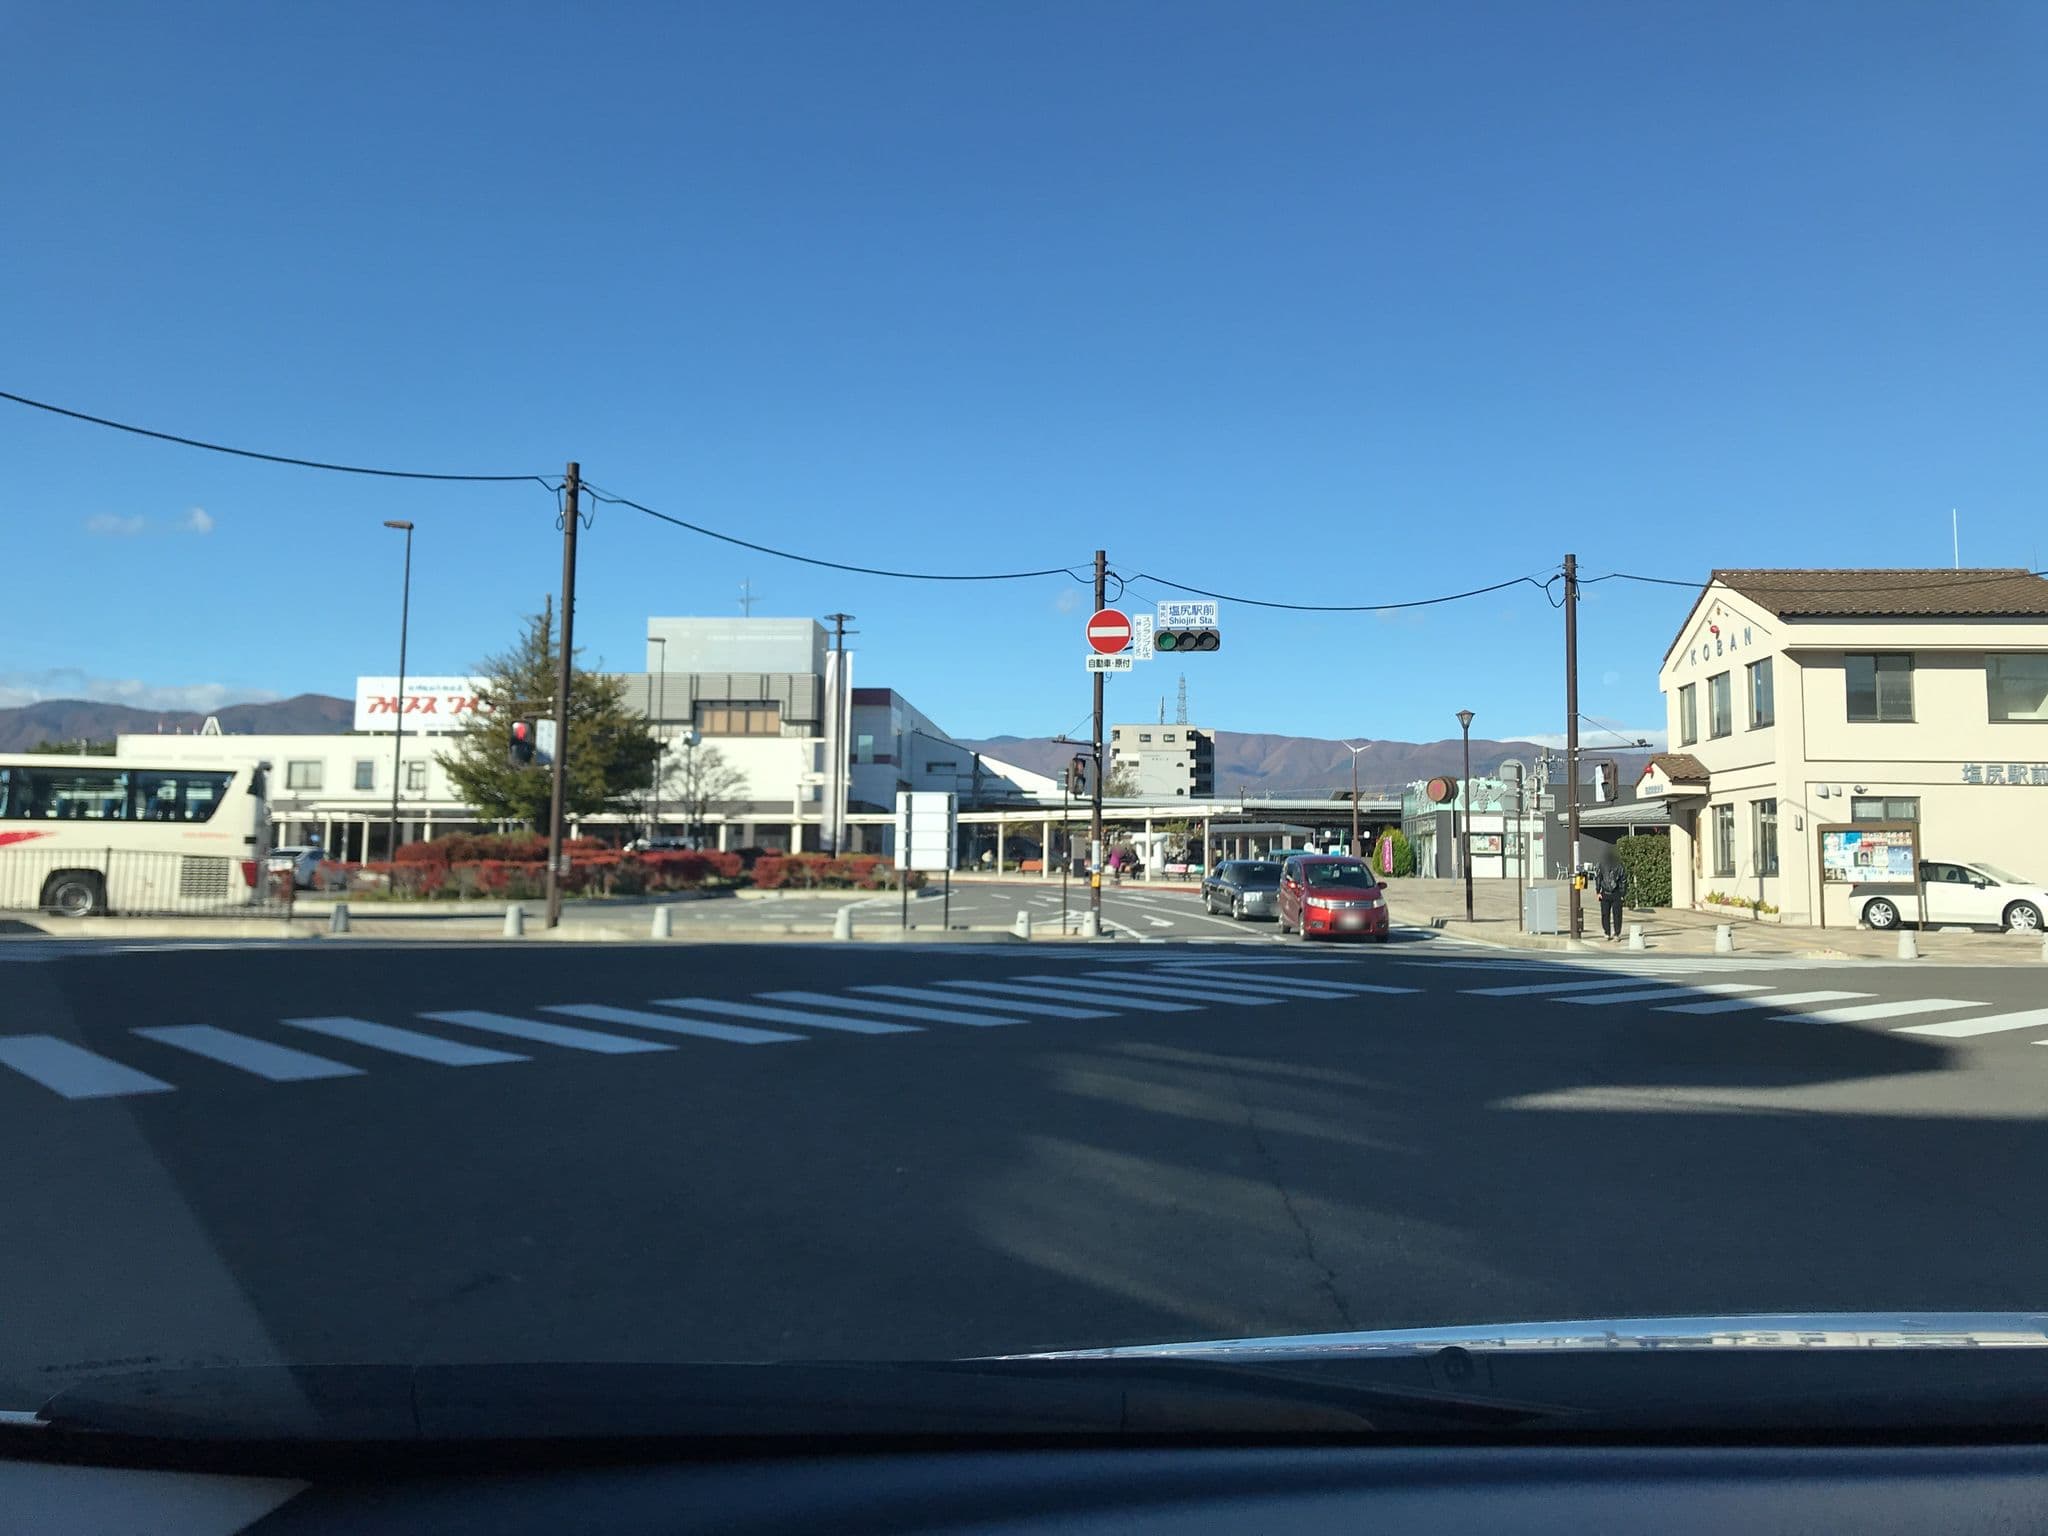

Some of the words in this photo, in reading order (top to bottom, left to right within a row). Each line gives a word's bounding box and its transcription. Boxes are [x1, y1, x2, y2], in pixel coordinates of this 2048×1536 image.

[1169, 604, 1214, 616] 塩尻駅前
[1169, 616, 1197, 626] Shiojiri
[1199, 616, 1215, 625] Sta.
[1143, 616, 1151, 658] スクランブル式
[1690, 626, 1752, 666] KOBAN
[1088, 658, 1130, 669] 自動車・原付
